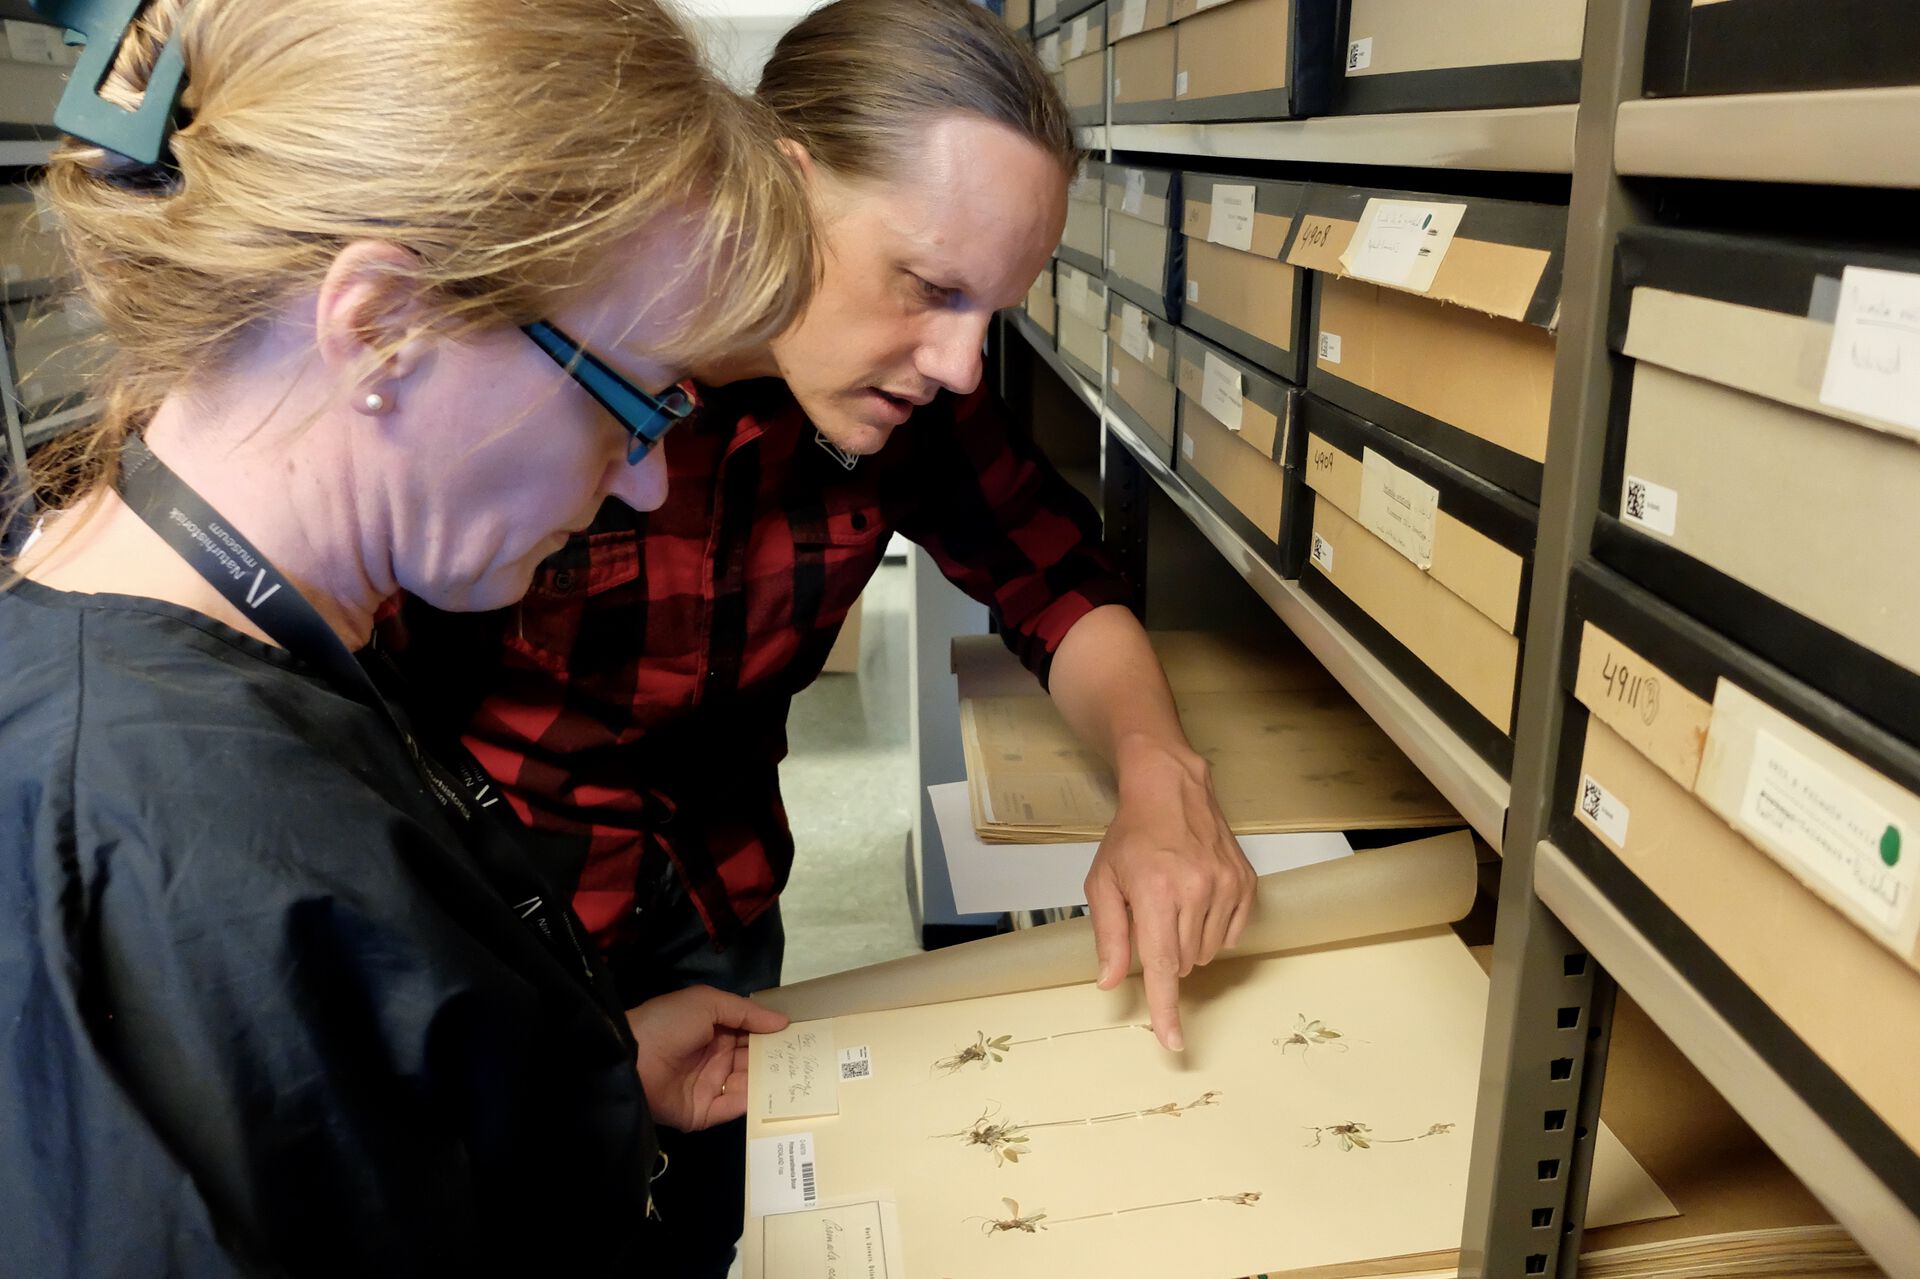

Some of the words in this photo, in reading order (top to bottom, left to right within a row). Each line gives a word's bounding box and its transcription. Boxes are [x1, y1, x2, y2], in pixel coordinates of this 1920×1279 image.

[1302, 223, 1332, 249] 4908
[1314, 451, 1334, 473] 4909
[169, 506, 246, 580] Naturhistorisk
[207, 521, 257, 568] museum
[1602, 653, 1641, 709] 4911
